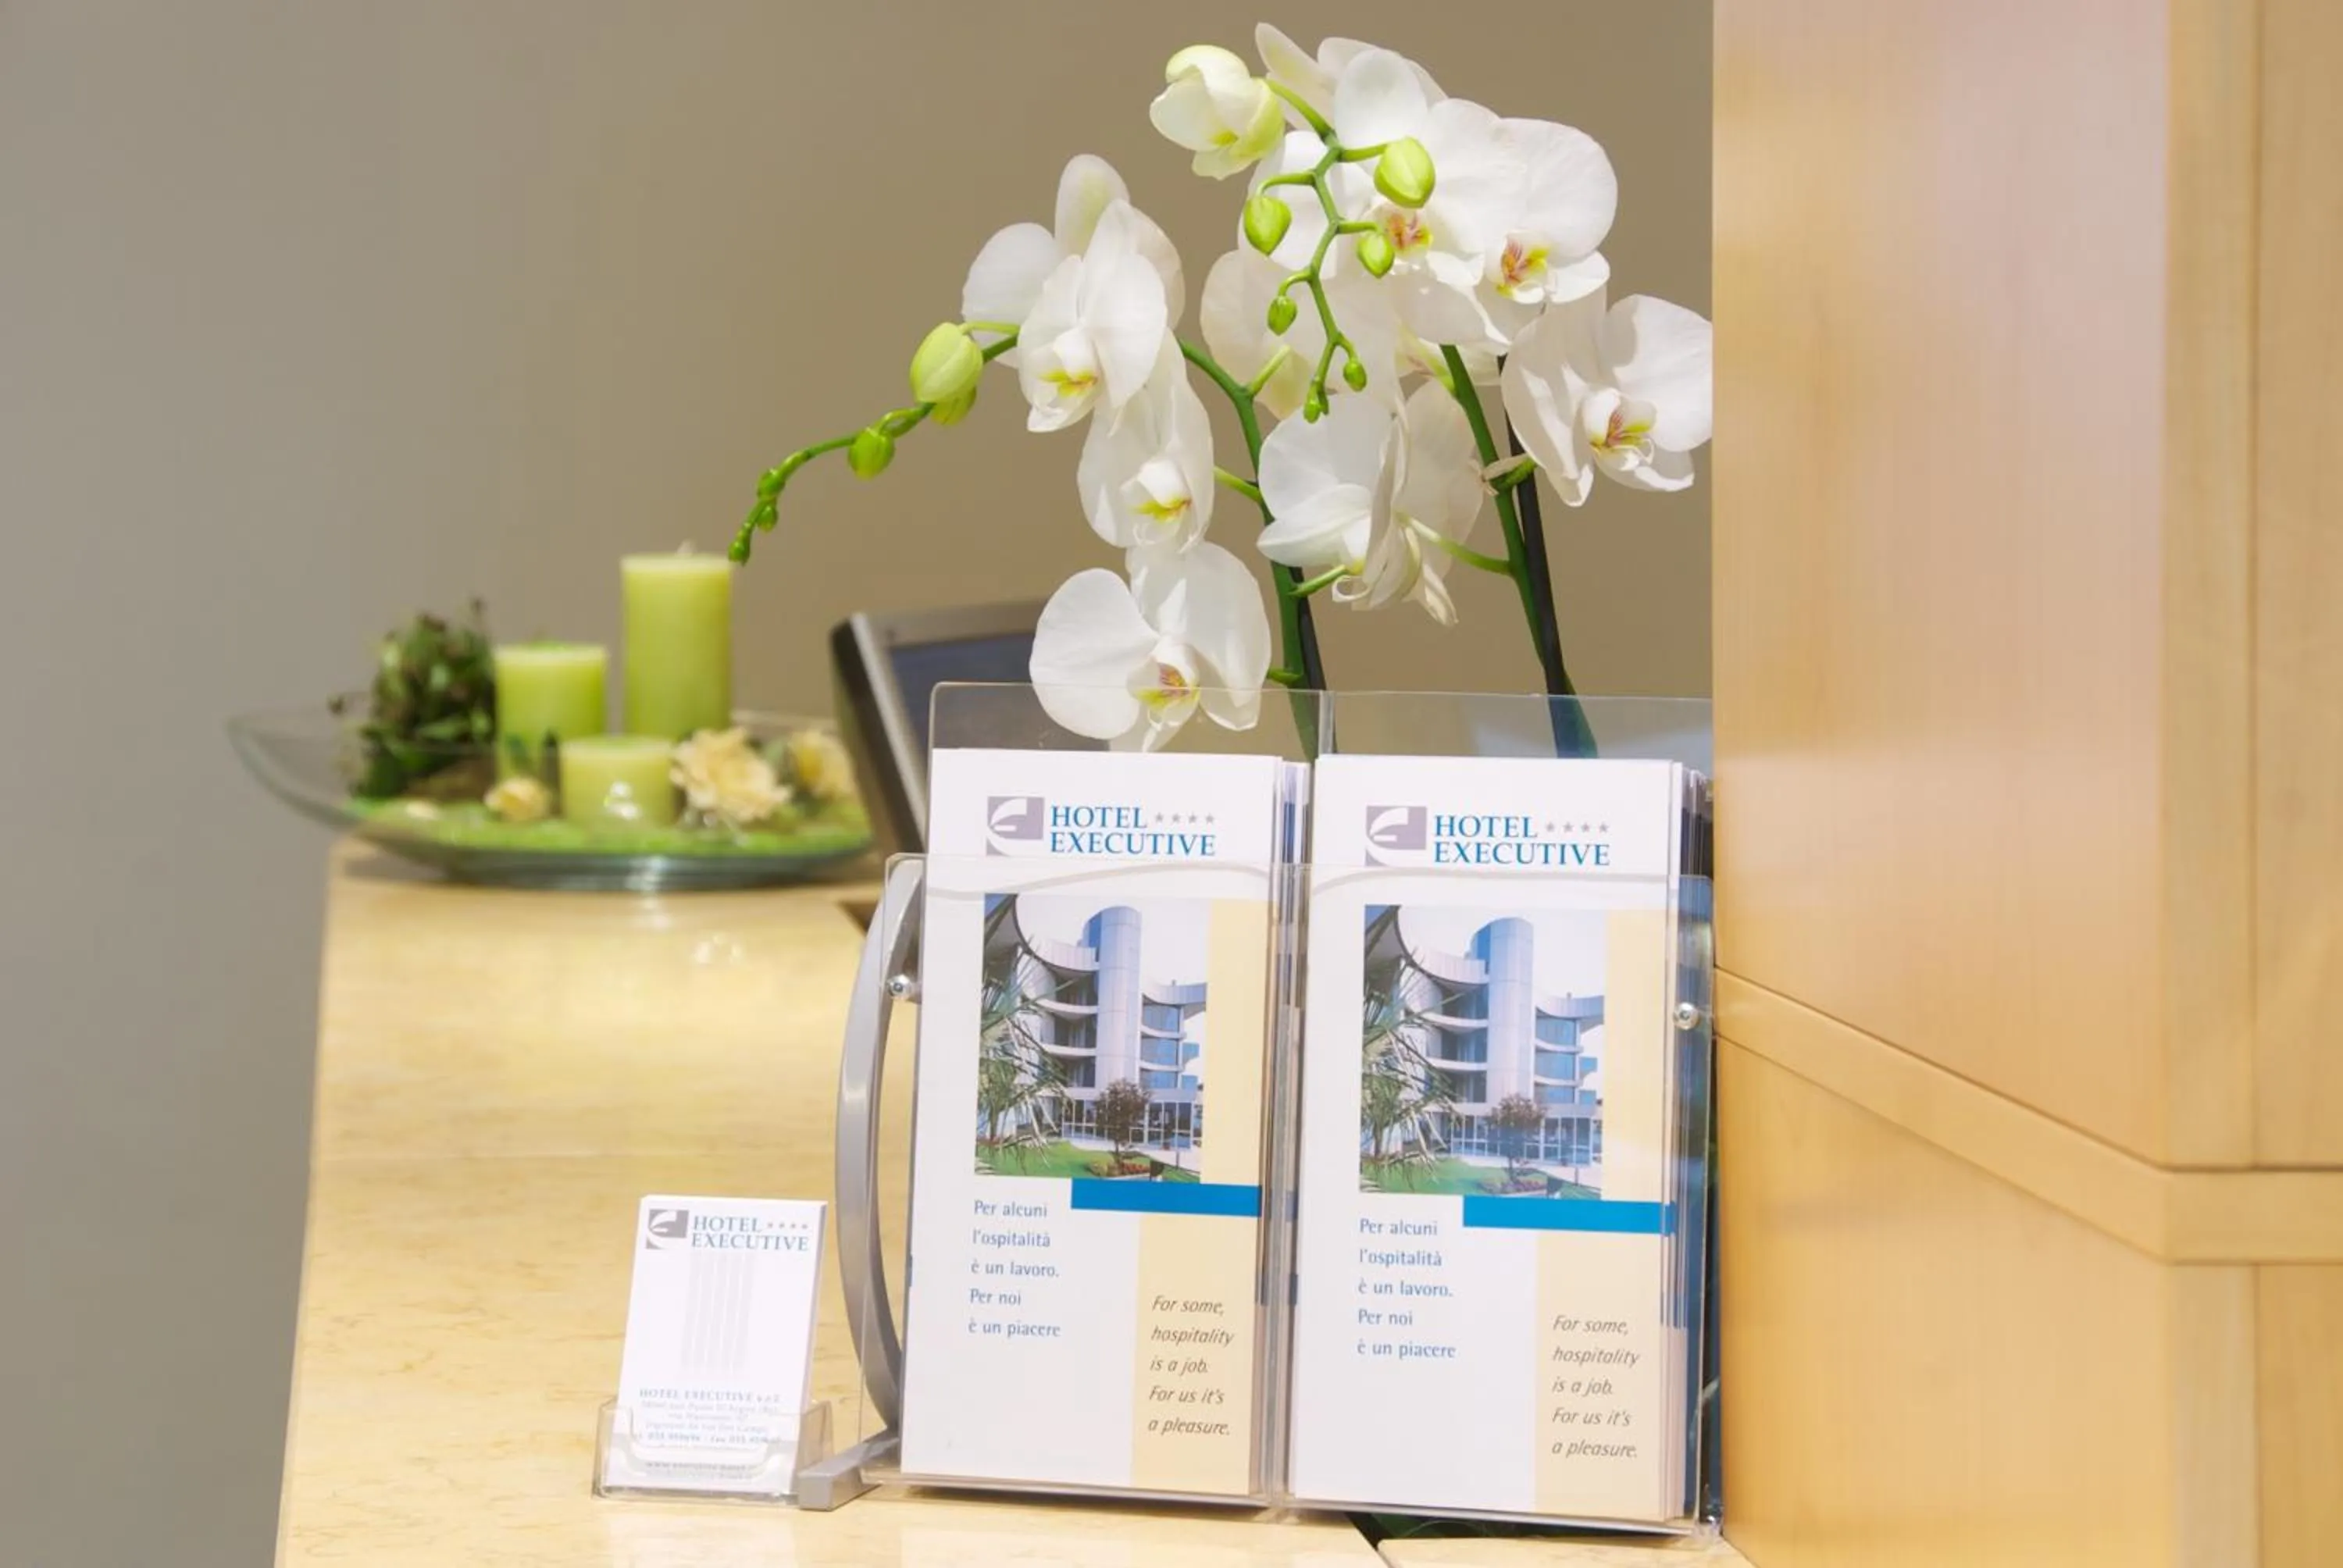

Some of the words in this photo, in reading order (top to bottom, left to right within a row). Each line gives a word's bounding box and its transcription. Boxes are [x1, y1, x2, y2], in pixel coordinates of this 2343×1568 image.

[1052, 806, 1147, 828] HOTEL
[1435, 815, 1537, 838] HOTEL
[1051, 832, 1214, 856] EXECUTIVE
[1435, 842, 1609, 865] EXECUTIVE
[975, 1199, 997, 1215] Per
[1003, 1202, 1047, 1217] alcuni
[693, 1216, 761, 1231] HOTEL
[1361, 1218, 1383, 1234] Per
[1390, 1220, 1437, 1235] alcuni
[691, 1233, 809, 1251] EXECUTIVE
[973, 1229, 1050, 1249] l'ospitalità
[971, 1260, 979, 1274] è
[986, 1263, 1004, 1274] un
[1360, 1249, 1442, 1268] l'ospitalità
[1358, 1278, 1367, 1294] è
[1374, 1284, 1393, 1294] un
[970, 1288, 993, 1303] Per
[999, 1290, 1022, 1306] noi
[1152, 1295, 1178, 1311] For
[1359, 1309, 1382, 1324] Per
[1389, 1311, 1412, 1325] noi
[1553, 1315, 1581, 1331] For
[968, 1317, 977, 1333] è
[982, 1324, 1001, 1334] un
[1007, 1320, 1060, 1338] piacere
[1151, 1325, 1234, 1347] hospitality
[1357, 1338, 1366, 1354] è
[1372, 1344, 1392, 1355] un
[1399, 1342, 1456, 1360] piacere
[1553, 1346, 1640, 1368] hospitality
[1150, 1356, 1163, 1370] is
[1168, 1360, 1178, 1371] a
[1552, 1376, 1566, 1392] is
[1571, 1380, 1582, 1392] a
[1149, 1385, 1175, 1401] For
[1179, 1392, 1196, 1402] us
[1201, 1388, 1225, 1404] it's
[1148, 1418, 1159, 1431] a
[1552, 1407, 1579, 1423] For
[1583, 1413, 1602, 1424] us
[1607, 1410, 1631, 1426] it's
[1552, 1442, 1563, 1454] a
